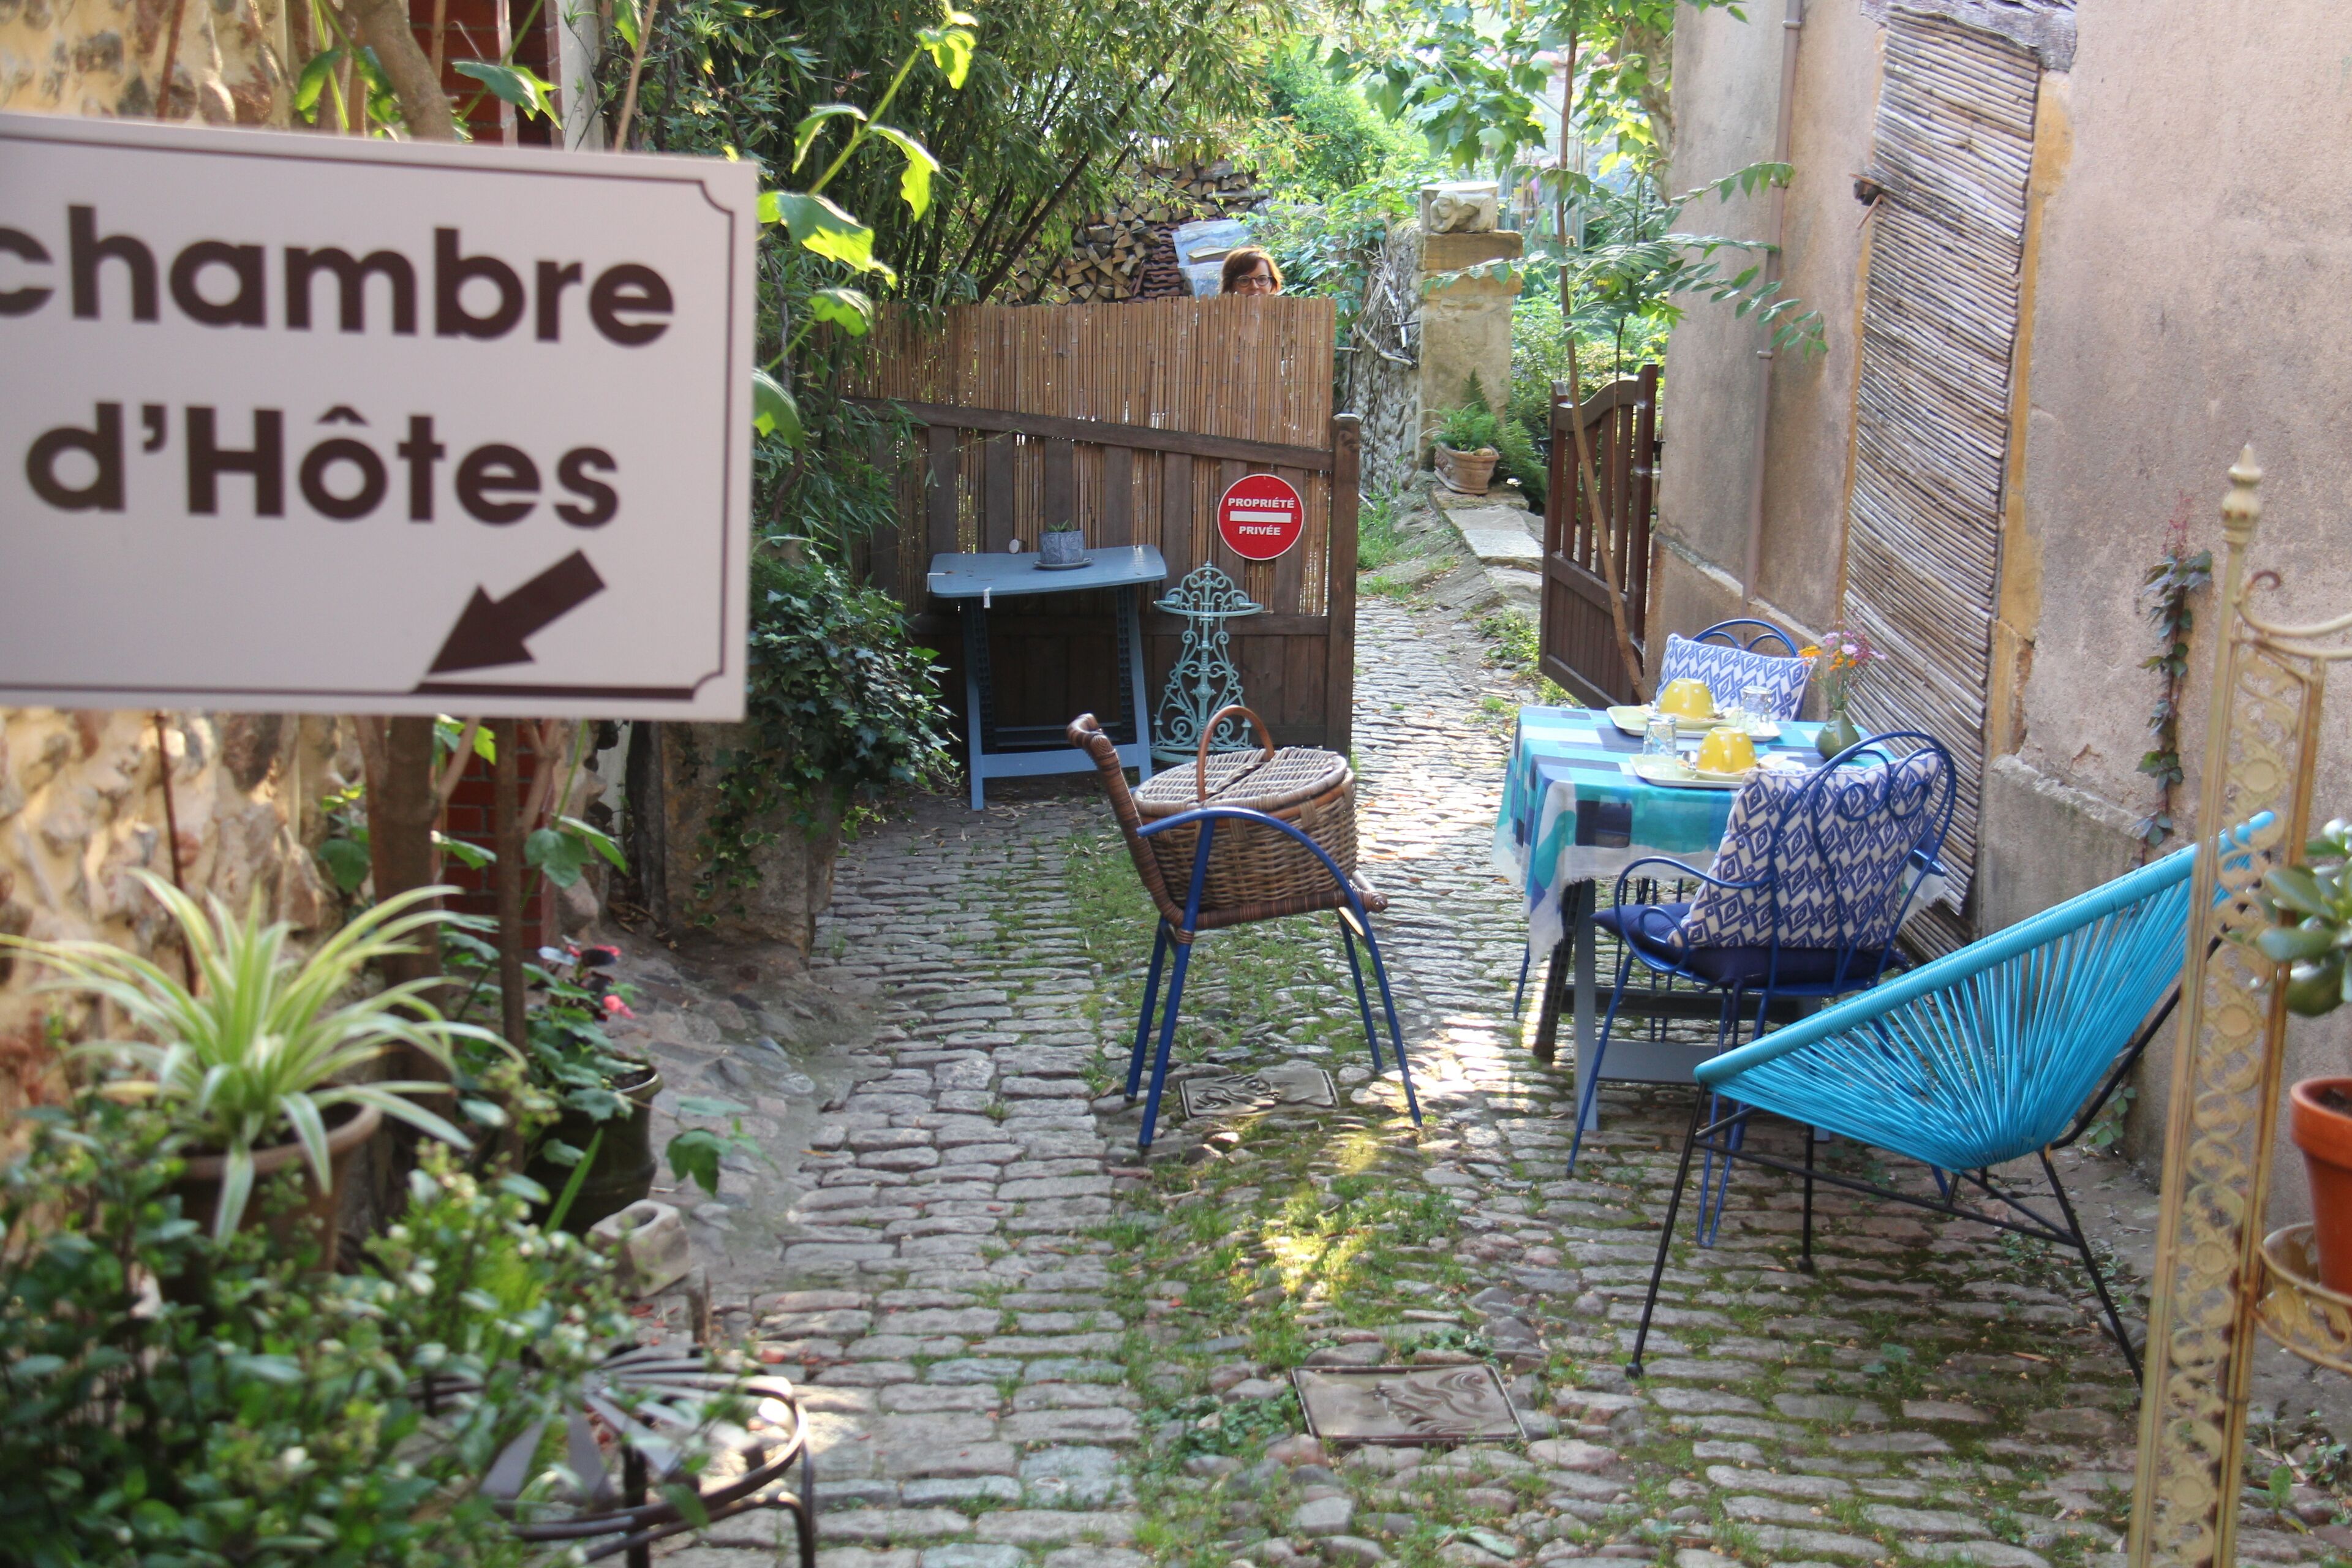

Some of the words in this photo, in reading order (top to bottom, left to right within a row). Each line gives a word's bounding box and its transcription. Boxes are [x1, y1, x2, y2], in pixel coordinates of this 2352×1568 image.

[24, 401, 620, 530] d’Hôtes
[1227, 497, 1294, 508] PROPRIÉTÉ
[1238, 525, 1281, 535] PRIVÉE
